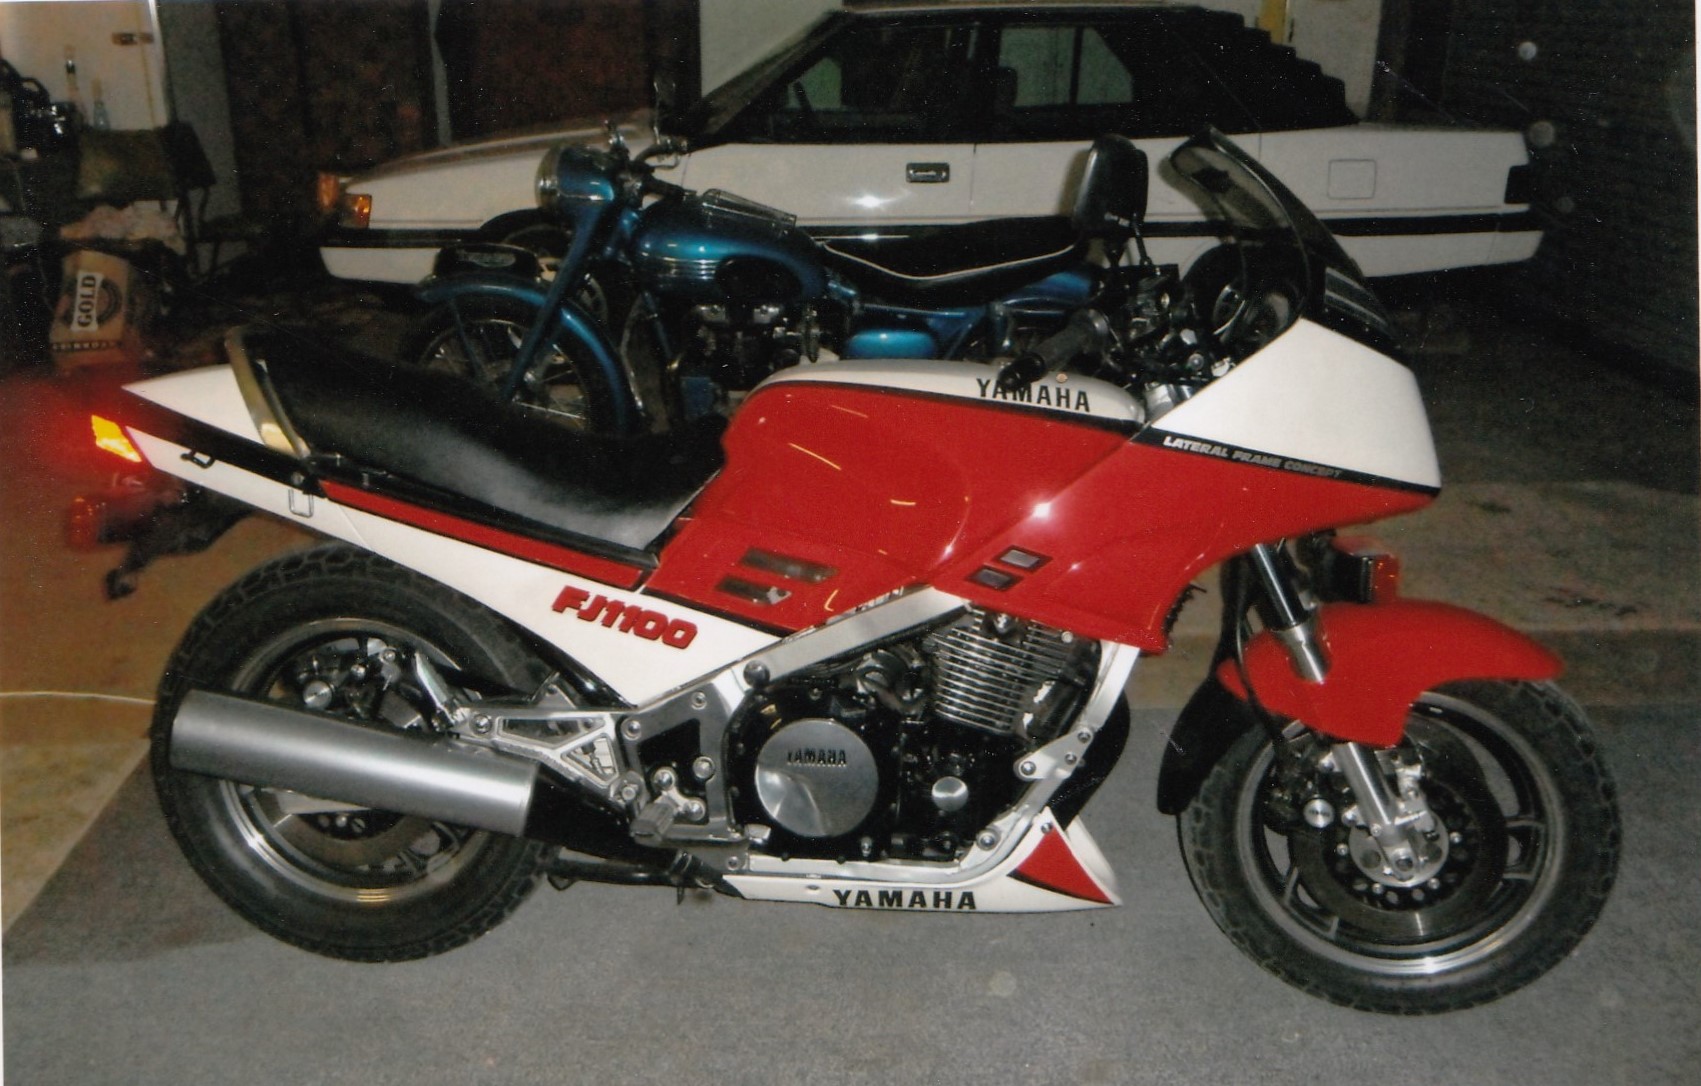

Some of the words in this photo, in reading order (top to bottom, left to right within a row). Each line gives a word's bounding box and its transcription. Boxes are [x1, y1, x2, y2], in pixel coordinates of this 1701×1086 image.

[78, 275, 96, 327] GOLD
[976, 378, 1090, 412] YAMAHA
[1163, 436, 1229, 457] LATERAL
[1232, 450, 1282, 469] FRAME
[1284, 460, 1342, 478] CONCEPT
[552, 586, 698, 649] FJ1100
[786, 748, 846, 767] YAMAHA
[833, 889, 977, 910] YAMAHA
